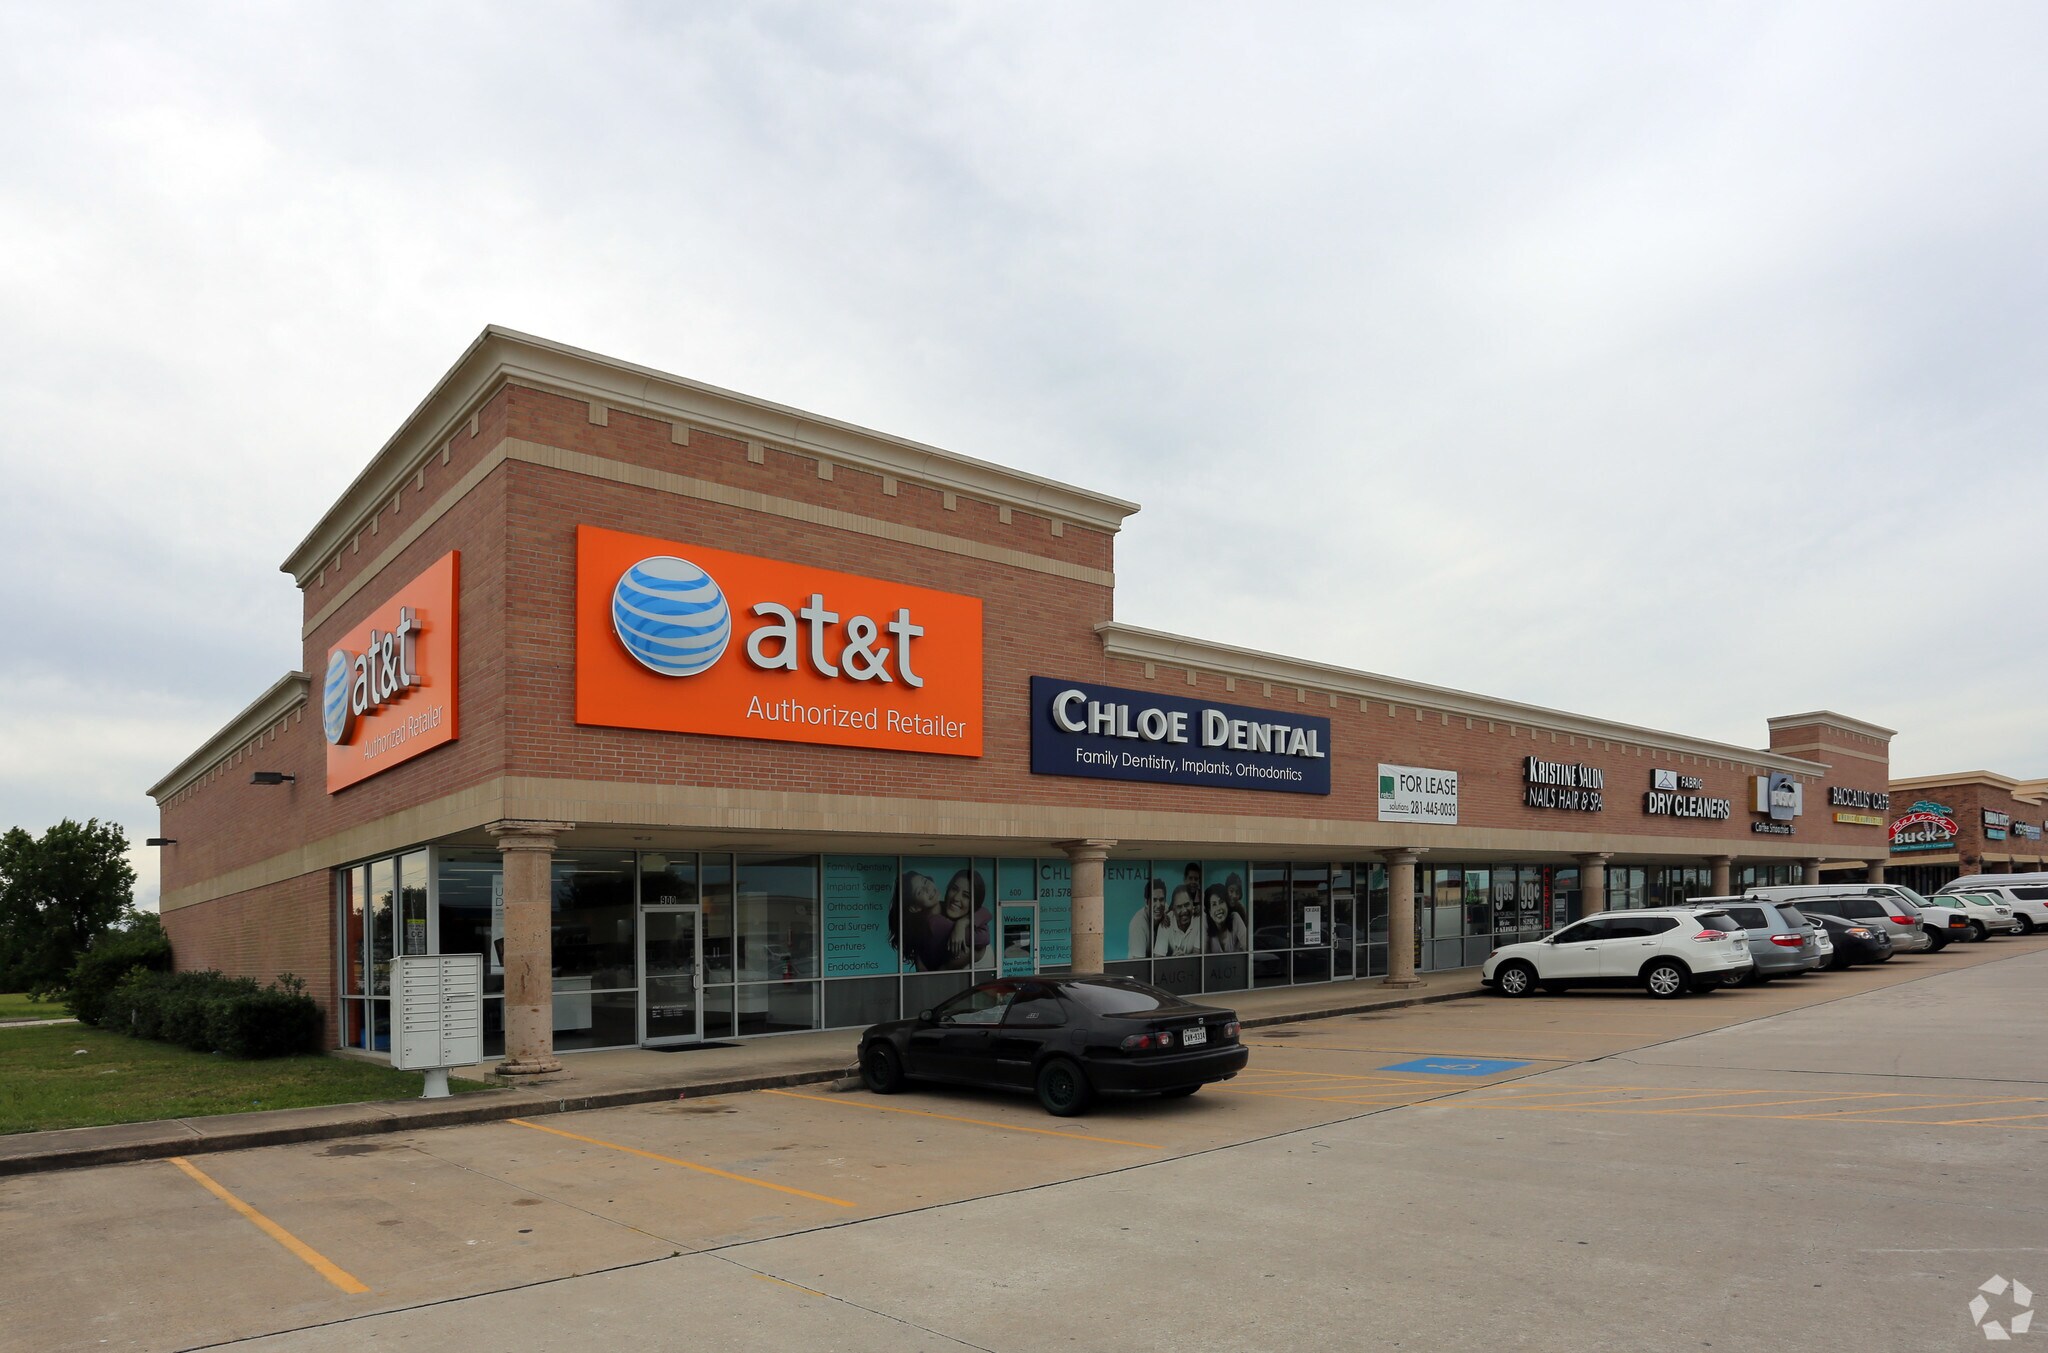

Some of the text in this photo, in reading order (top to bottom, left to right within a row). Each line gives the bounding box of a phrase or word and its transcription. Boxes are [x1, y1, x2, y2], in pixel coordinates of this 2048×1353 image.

[744, 593, 924, 689] at&t
[352, 606, 414, 716] at&t
[746, 695, 967, 739] Authorized Retailer
[1052, 689, 1326, 758] CHLOE DENTAL
[363, 704, 443, 761] Authorized Retailer
[1076, 748, 1303, 782] Family Dentistry, Implants, Orthodontics
[1400, 774, 1456, 796] FOR LEASE
[1681, 776, 1704, 790] FABRIC
[1389, 800, 1409, 811] solutions
[1529, 787, 1603, 812] NAILS HAIR & SPA
[1649, 791, 1730, 819] DRY CLEANERS
[1872, 793, 1889, 810] CAFE
[1410, 800, 1456, 817] 281-445-0033
[1892, 814, 1952, 832] Bahama
[827, 862, 892, 873] Family Dentistry
[1040, 864, 1150, 880] CHL ENTAL
[827, 882, 892, 894] Implant Surgery
[1009, 889, 1022, 897] 600
[1040, 888, 1071, 898] 281.578
[660, 896, 676, 905] 900
[827, 902, 884, 912] Orthodontics
[827, 921, 880, 933] Oral Surgery
[827, 941, 866, 952] Dentures
[828, 961, 879, 972] Endodontics
